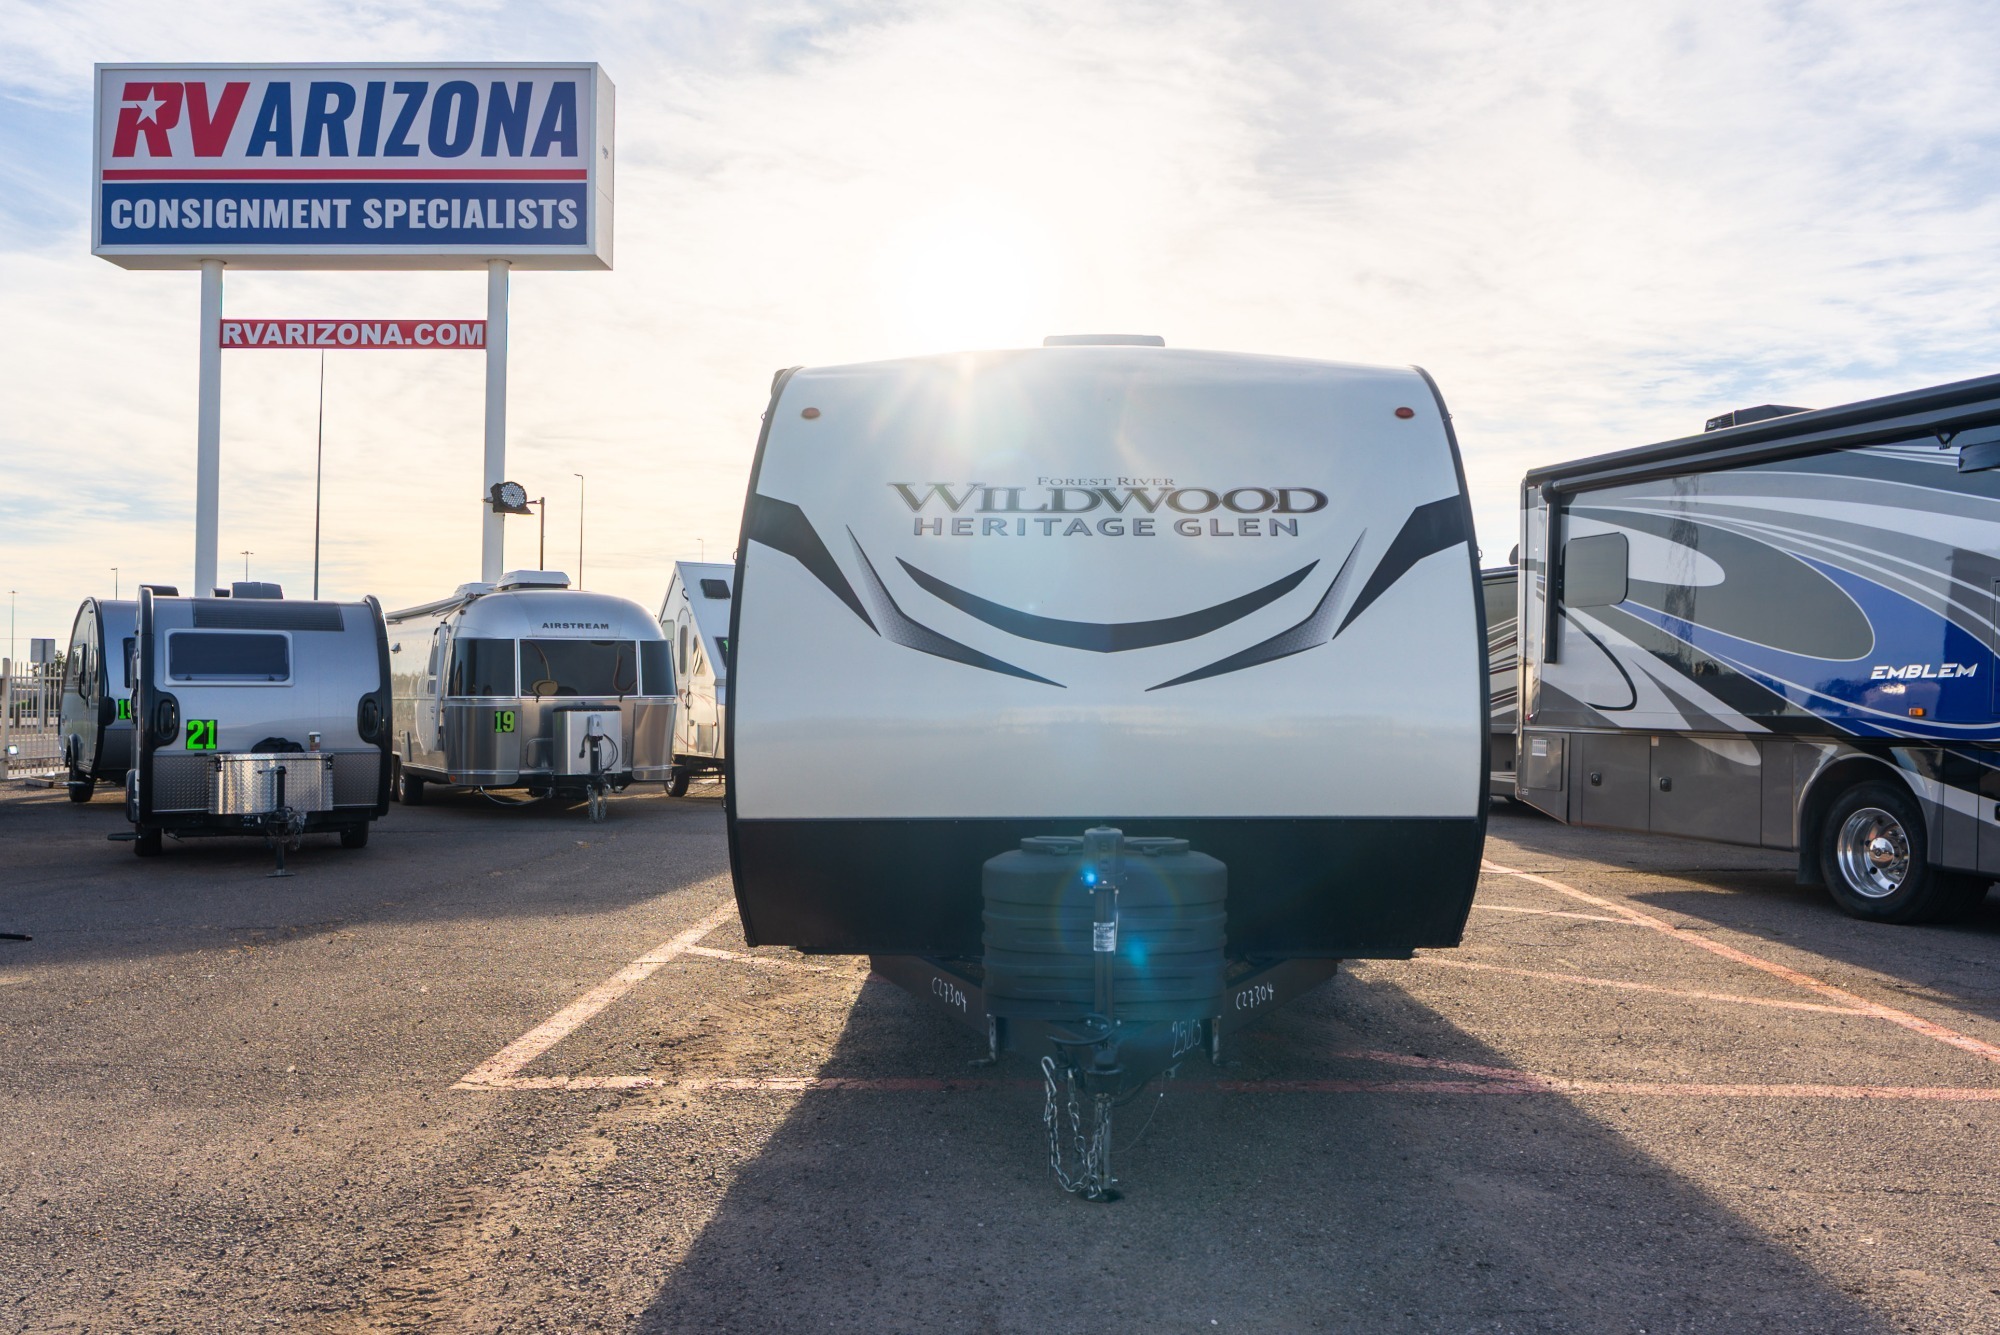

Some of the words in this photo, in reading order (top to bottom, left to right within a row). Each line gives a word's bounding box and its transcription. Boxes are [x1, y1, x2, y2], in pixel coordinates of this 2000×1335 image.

[245, 80, 579, 158] ARIZONA
[110, 198, 352, 231] CONSIGNMENT
[362, 198, 579, 230] SPECIALISTS
[222, 322, 484, 346] RVARIZONA.COM
[1037, 476, 1111, 486] FOREST
[1117, 476, 1176, 486] RIVER
[887, 482, 1329, 514] WILDWOOD
[913, 517, 1156, 537] HERITAGE
[1173, 517, 1299, 537] GLEN
[542, 622, 609, 630] AIRSTREAM
[1870, 663, 1978, 680] EMBLEM
[495, 711, 515, 733] 19
[187, 719, 216, 750] 21
